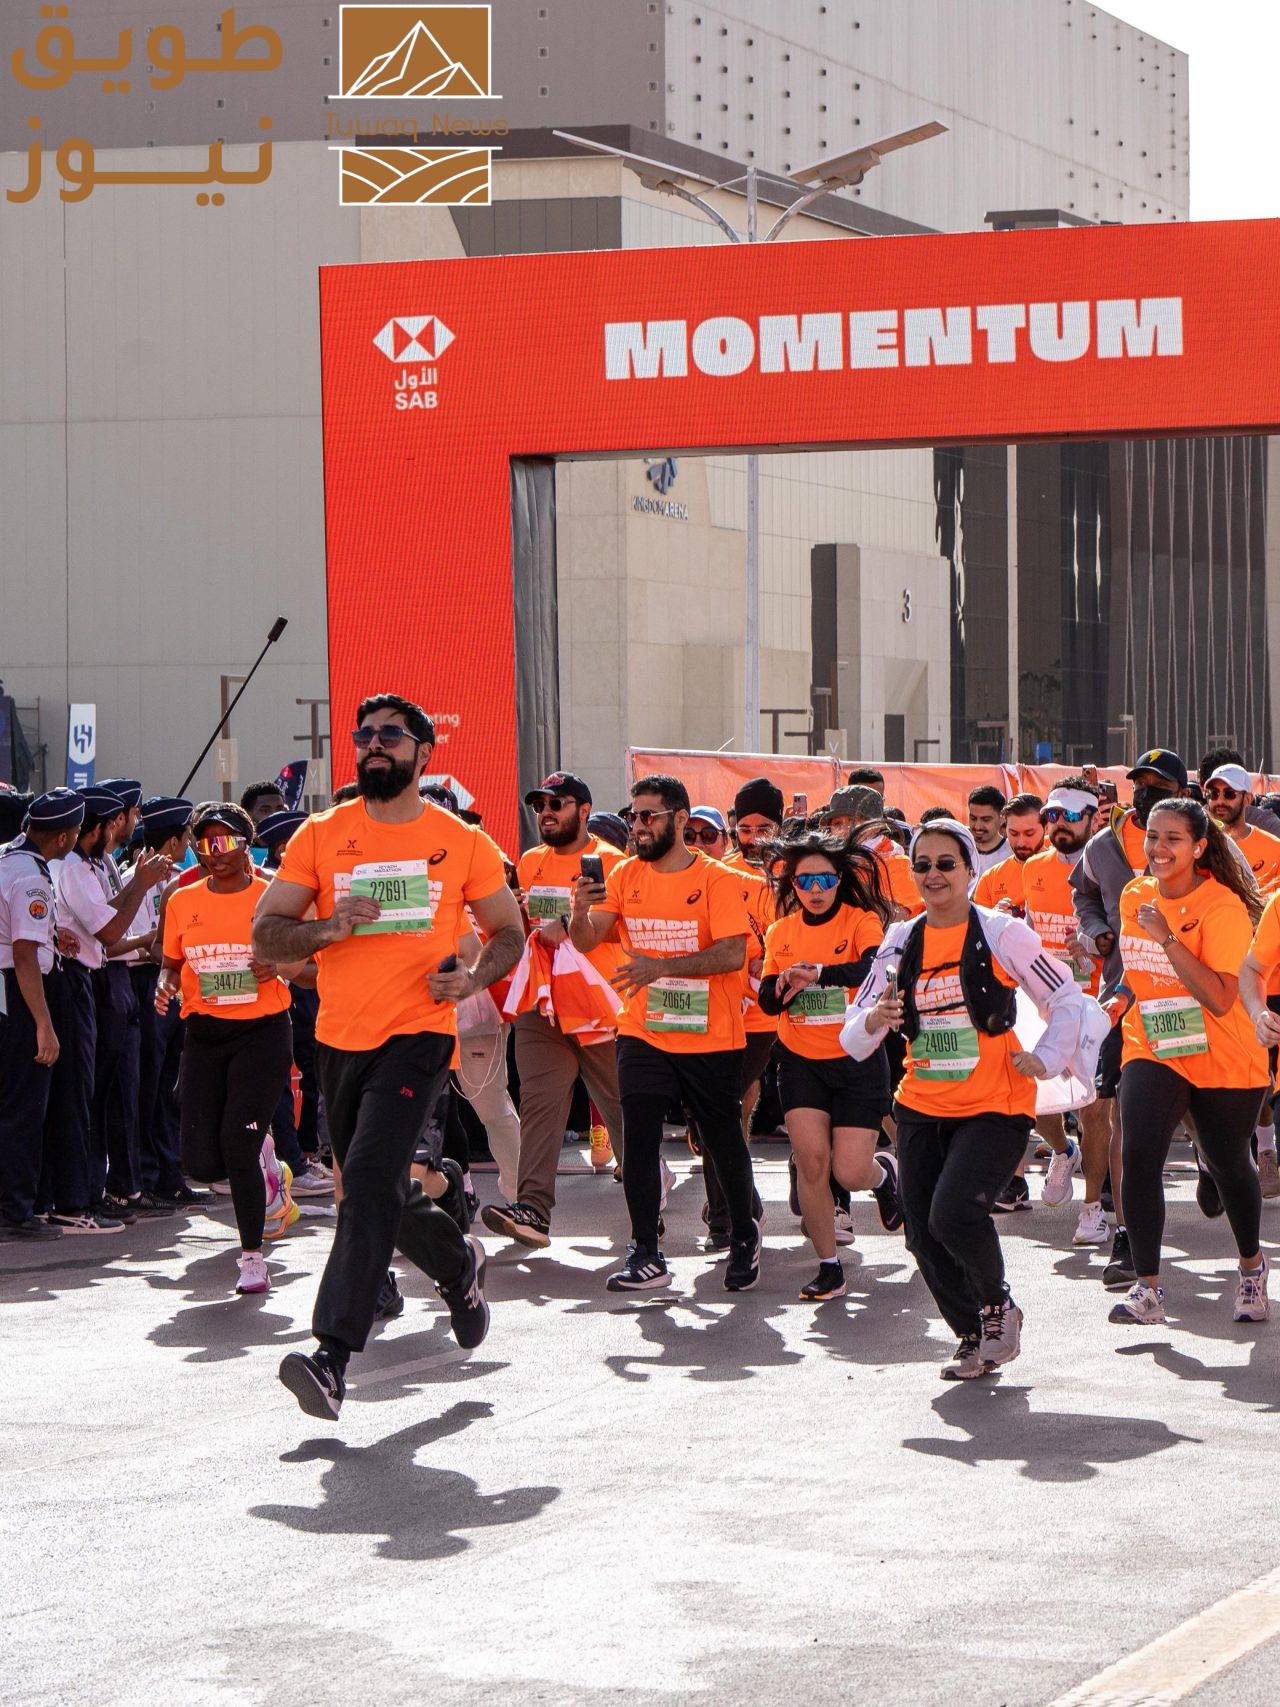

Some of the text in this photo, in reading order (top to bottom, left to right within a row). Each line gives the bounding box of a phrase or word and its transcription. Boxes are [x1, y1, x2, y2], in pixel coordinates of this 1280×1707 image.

[604, 297, 1184, 380] MOMENTUM
[395, 391, 438, 410] SAB
[902, 588, 913, 623] 3
[370, 880, 407, 902] 22691
[624, 917, 698, 931] RIYADH
[628, 929, 699, 940] MARATHON
[632, 937, 700, 953] RUNNER
[213, 973, 243, 991] 34477
[662, 991, 691, 1010] 20654
[1151, 1011, 1186, 1034] 33825
[924, 1031, 958, 1053] 24090
